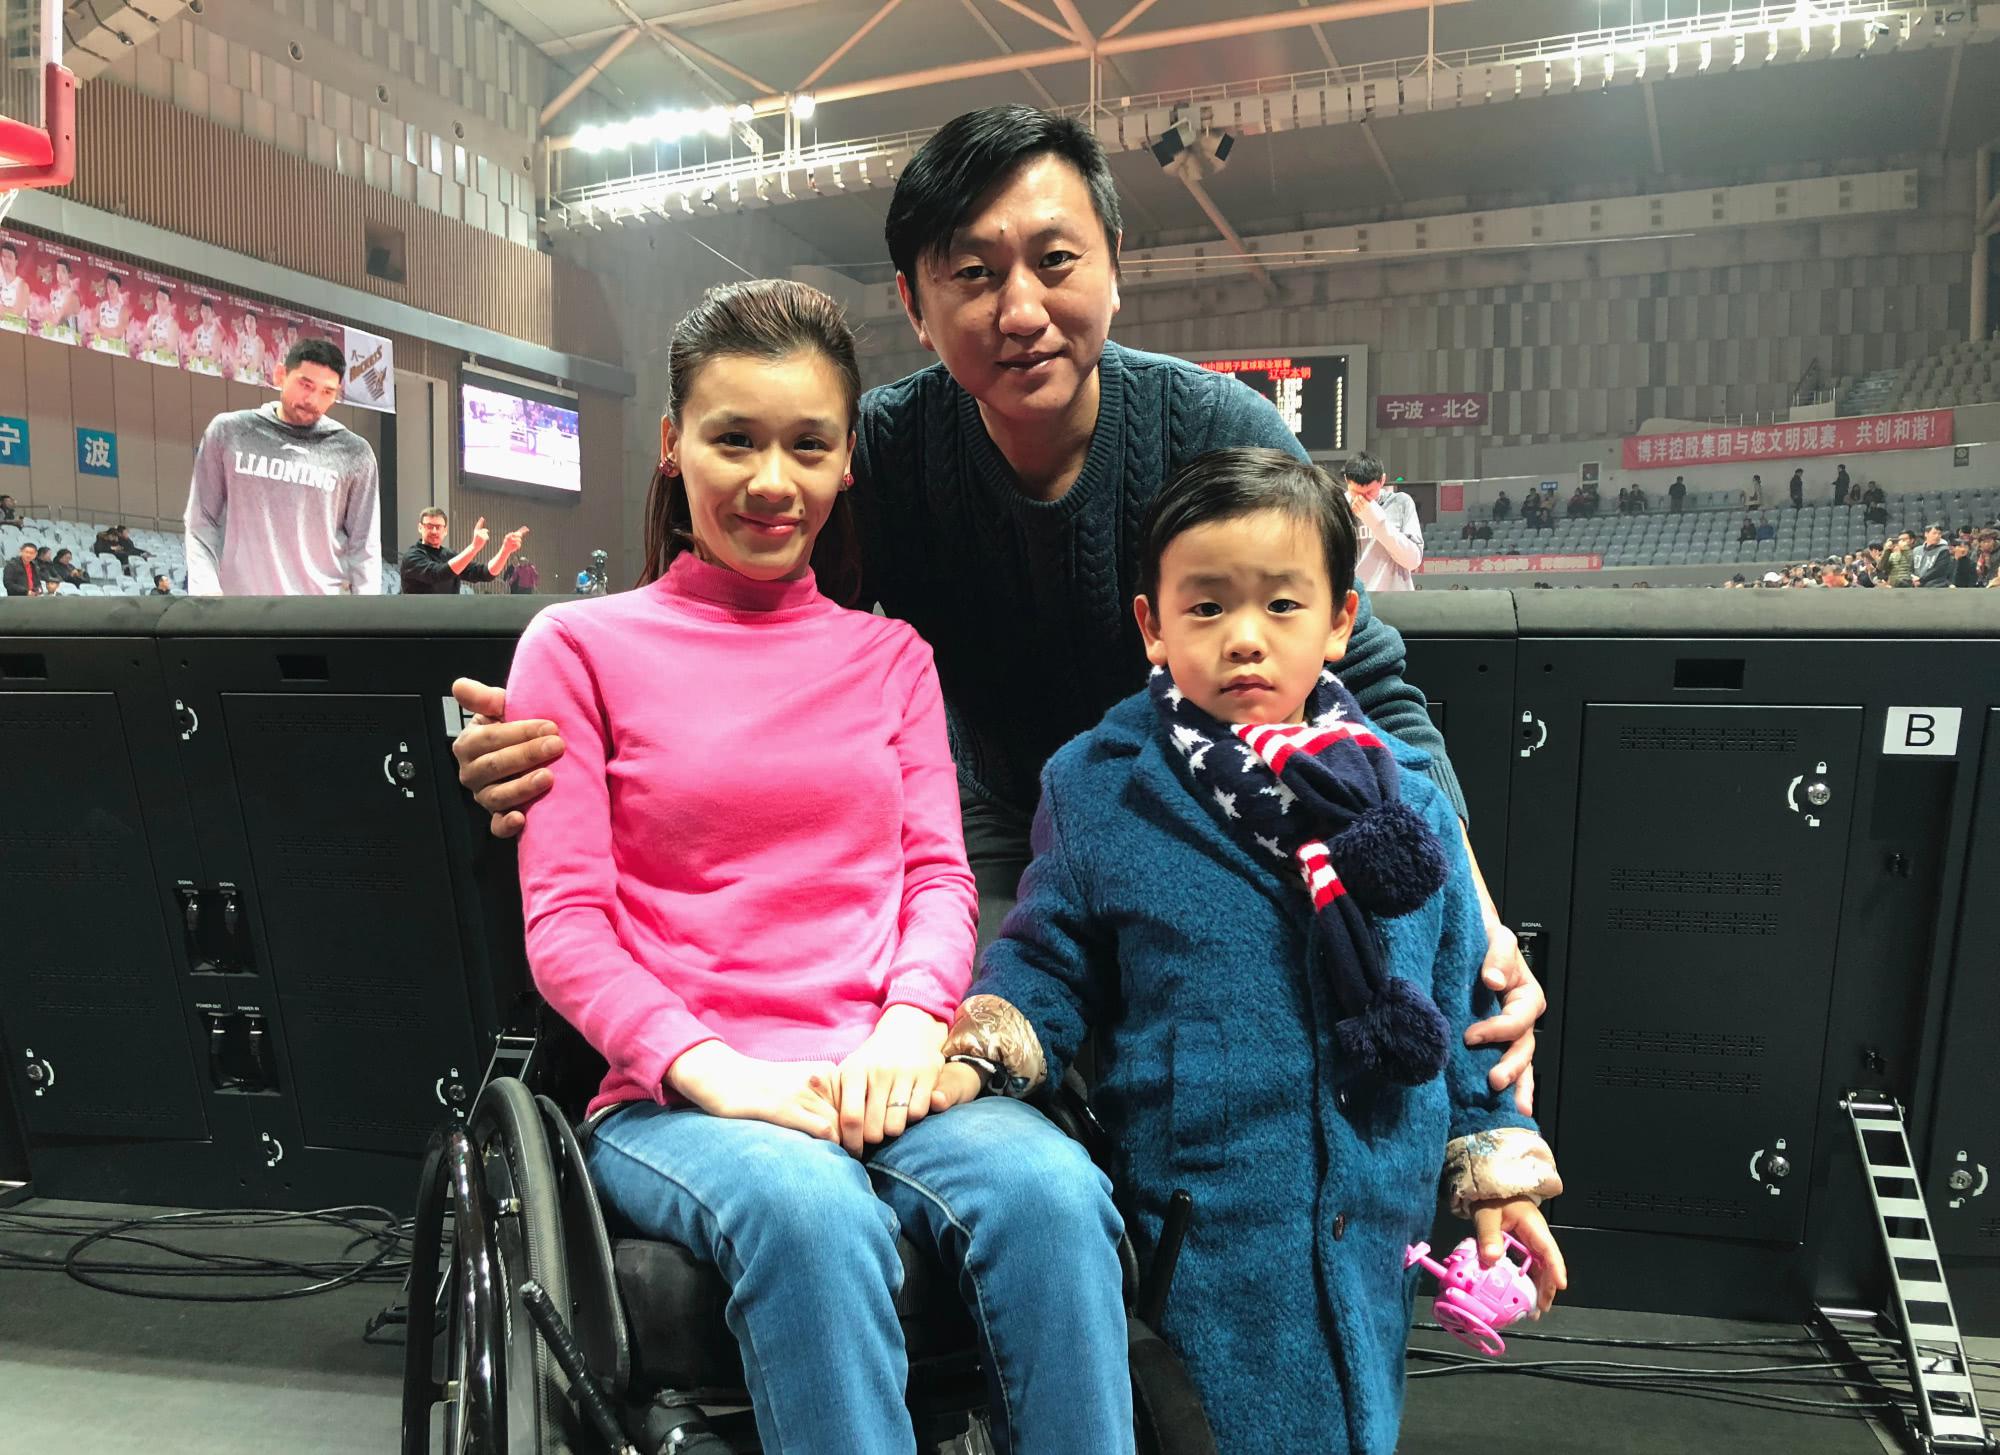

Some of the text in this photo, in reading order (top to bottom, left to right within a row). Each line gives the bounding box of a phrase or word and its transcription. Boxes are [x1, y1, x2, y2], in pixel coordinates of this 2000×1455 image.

[84, 436, 111, 468] 波
[234, 451, 339, 493] LIAONING
[1904, 713, 1936, 747] B
